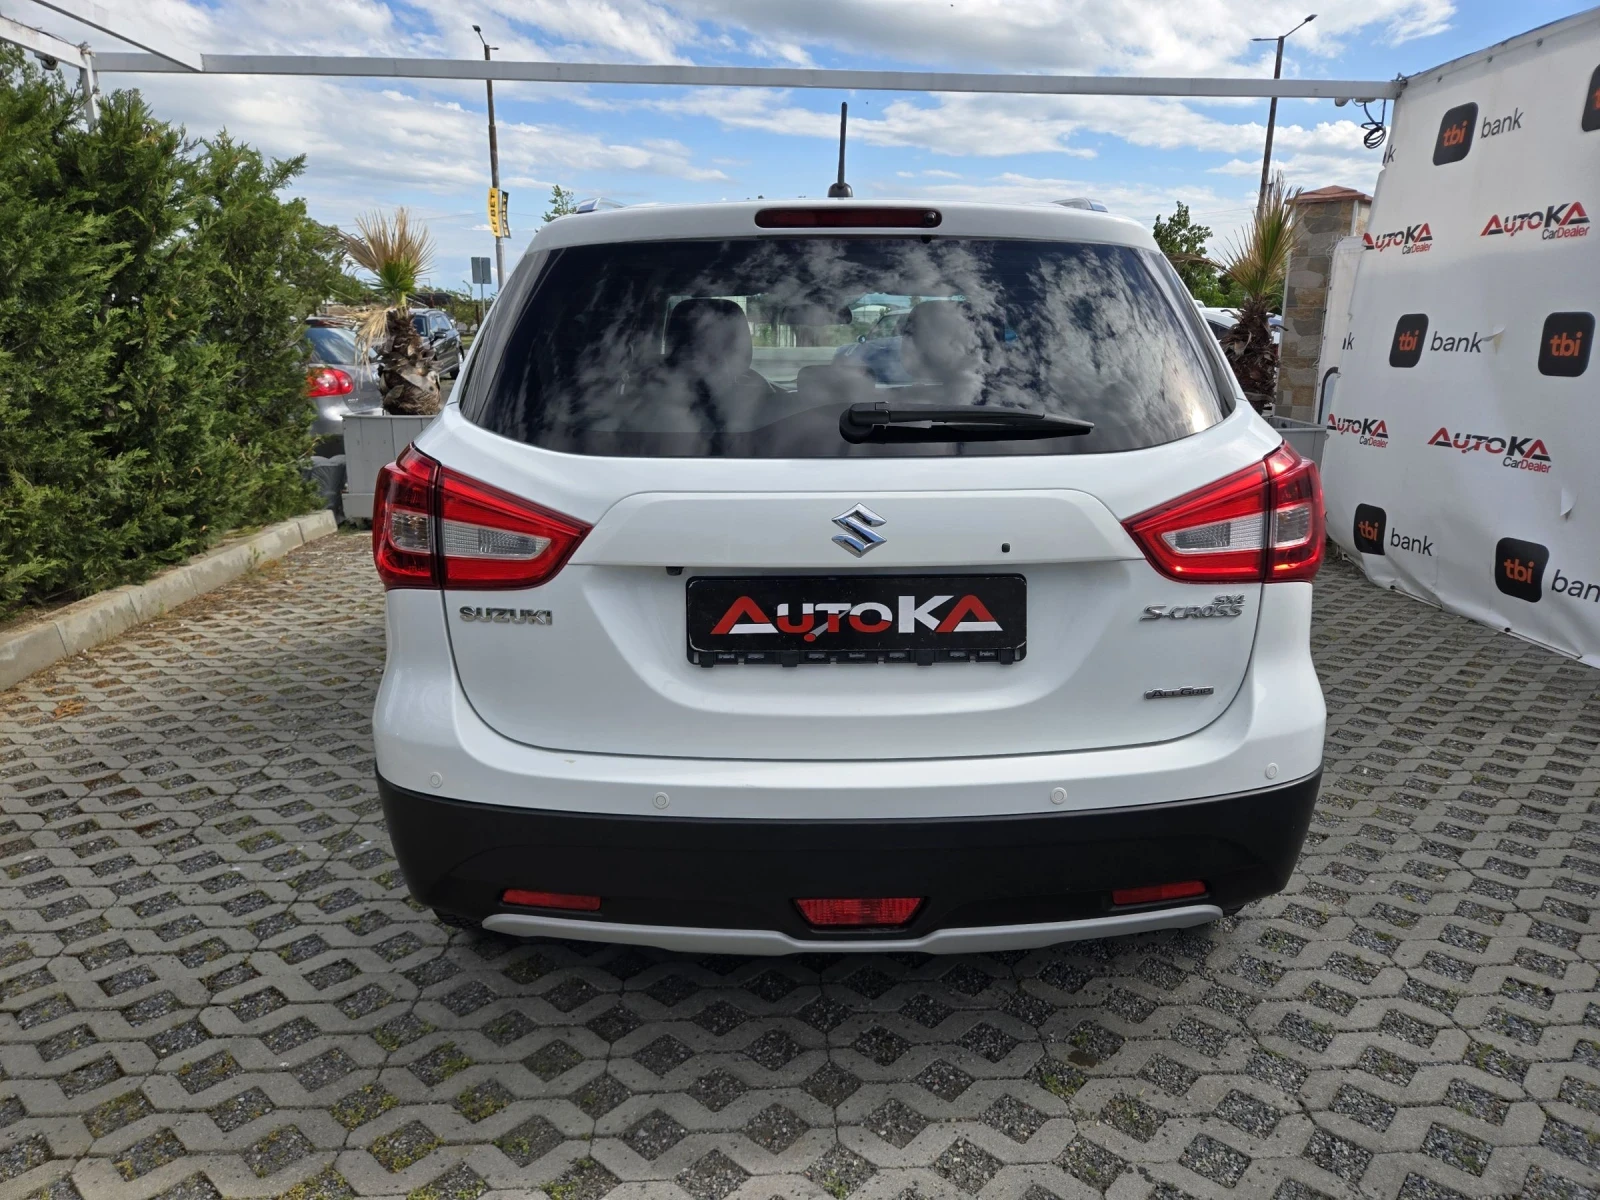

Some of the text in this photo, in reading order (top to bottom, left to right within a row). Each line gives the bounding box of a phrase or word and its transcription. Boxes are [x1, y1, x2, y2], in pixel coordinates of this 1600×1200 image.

[1443, 107, 1524, 147] tbi bank
[1480, 201, 1591, 237] AUTOKA
[1541, 225, 1590, 241] CarDealer
[1398, 329, 1482, 353] tbi bank
[1550, 331, 1583, 357] tbi
[1427, 427, 1552, 463] AUTOKA
[1502, 456, 1552, 474] CarDealer
[1358, 520, 1434, 557] tbi bank
[1503, 558, 1535, 584] tbi
[459, 606, 553, 625] SUZUKI
[710, 594, 1004, 643] AUTOKA
